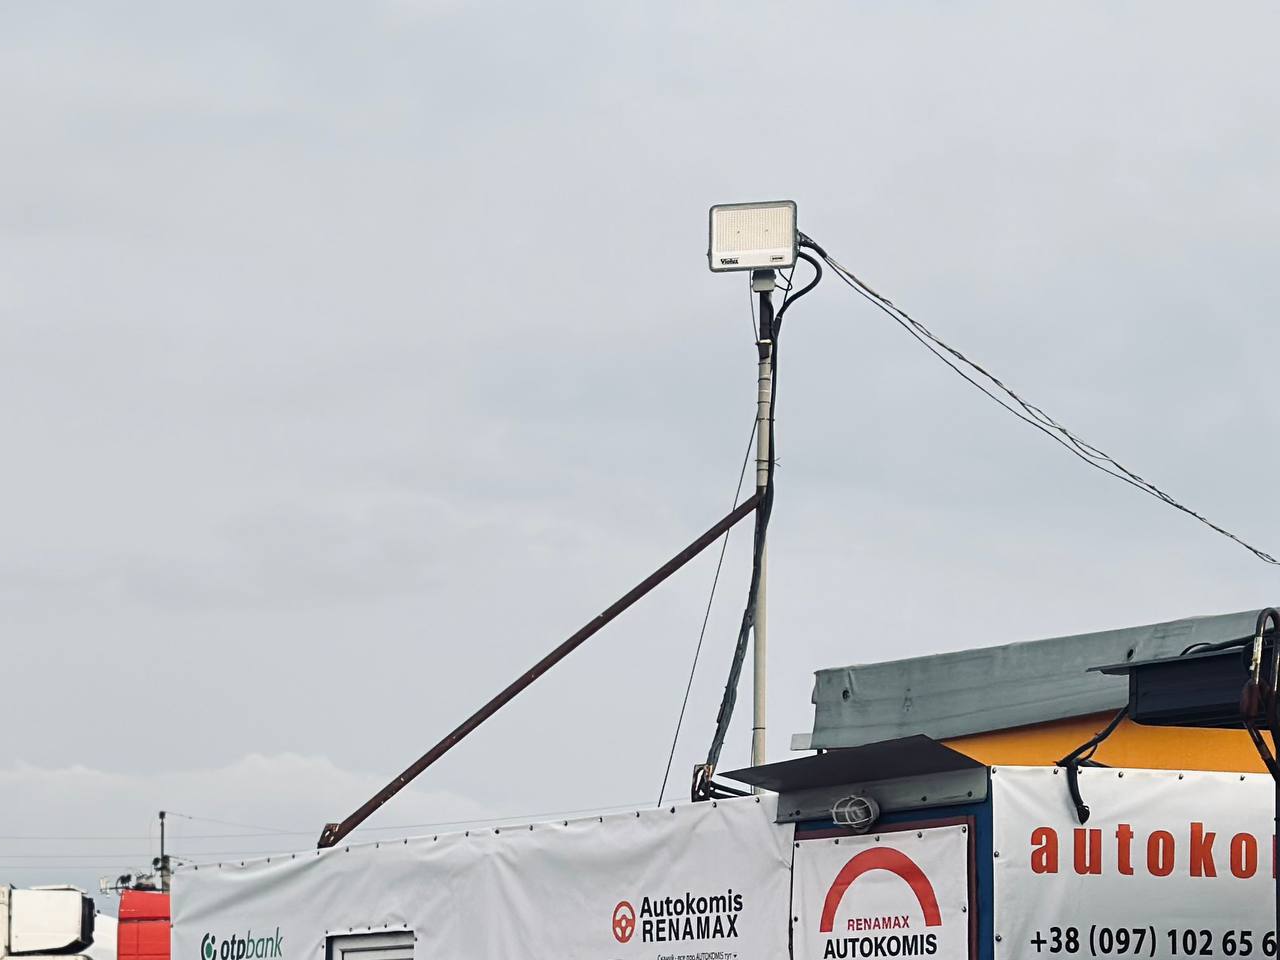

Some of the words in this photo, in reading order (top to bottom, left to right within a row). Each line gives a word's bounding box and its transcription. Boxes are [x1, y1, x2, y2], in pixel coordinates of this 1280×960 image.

[1030, 822, 1277, 879] autoko
[640, 889, 743, 918] Autokomis
[642, 914, 738, 942] RENAMAX
[847, 915, 910, 931] RENAMAX
[823, 933, 938, 959] AUTOKOMIS
[1030, 926, 1080, 954] +38
[1089, 924, 1157, 957] (097)
[1167, 929, 1213, 956] 102
[1222, 930, 1253, 957] 65
